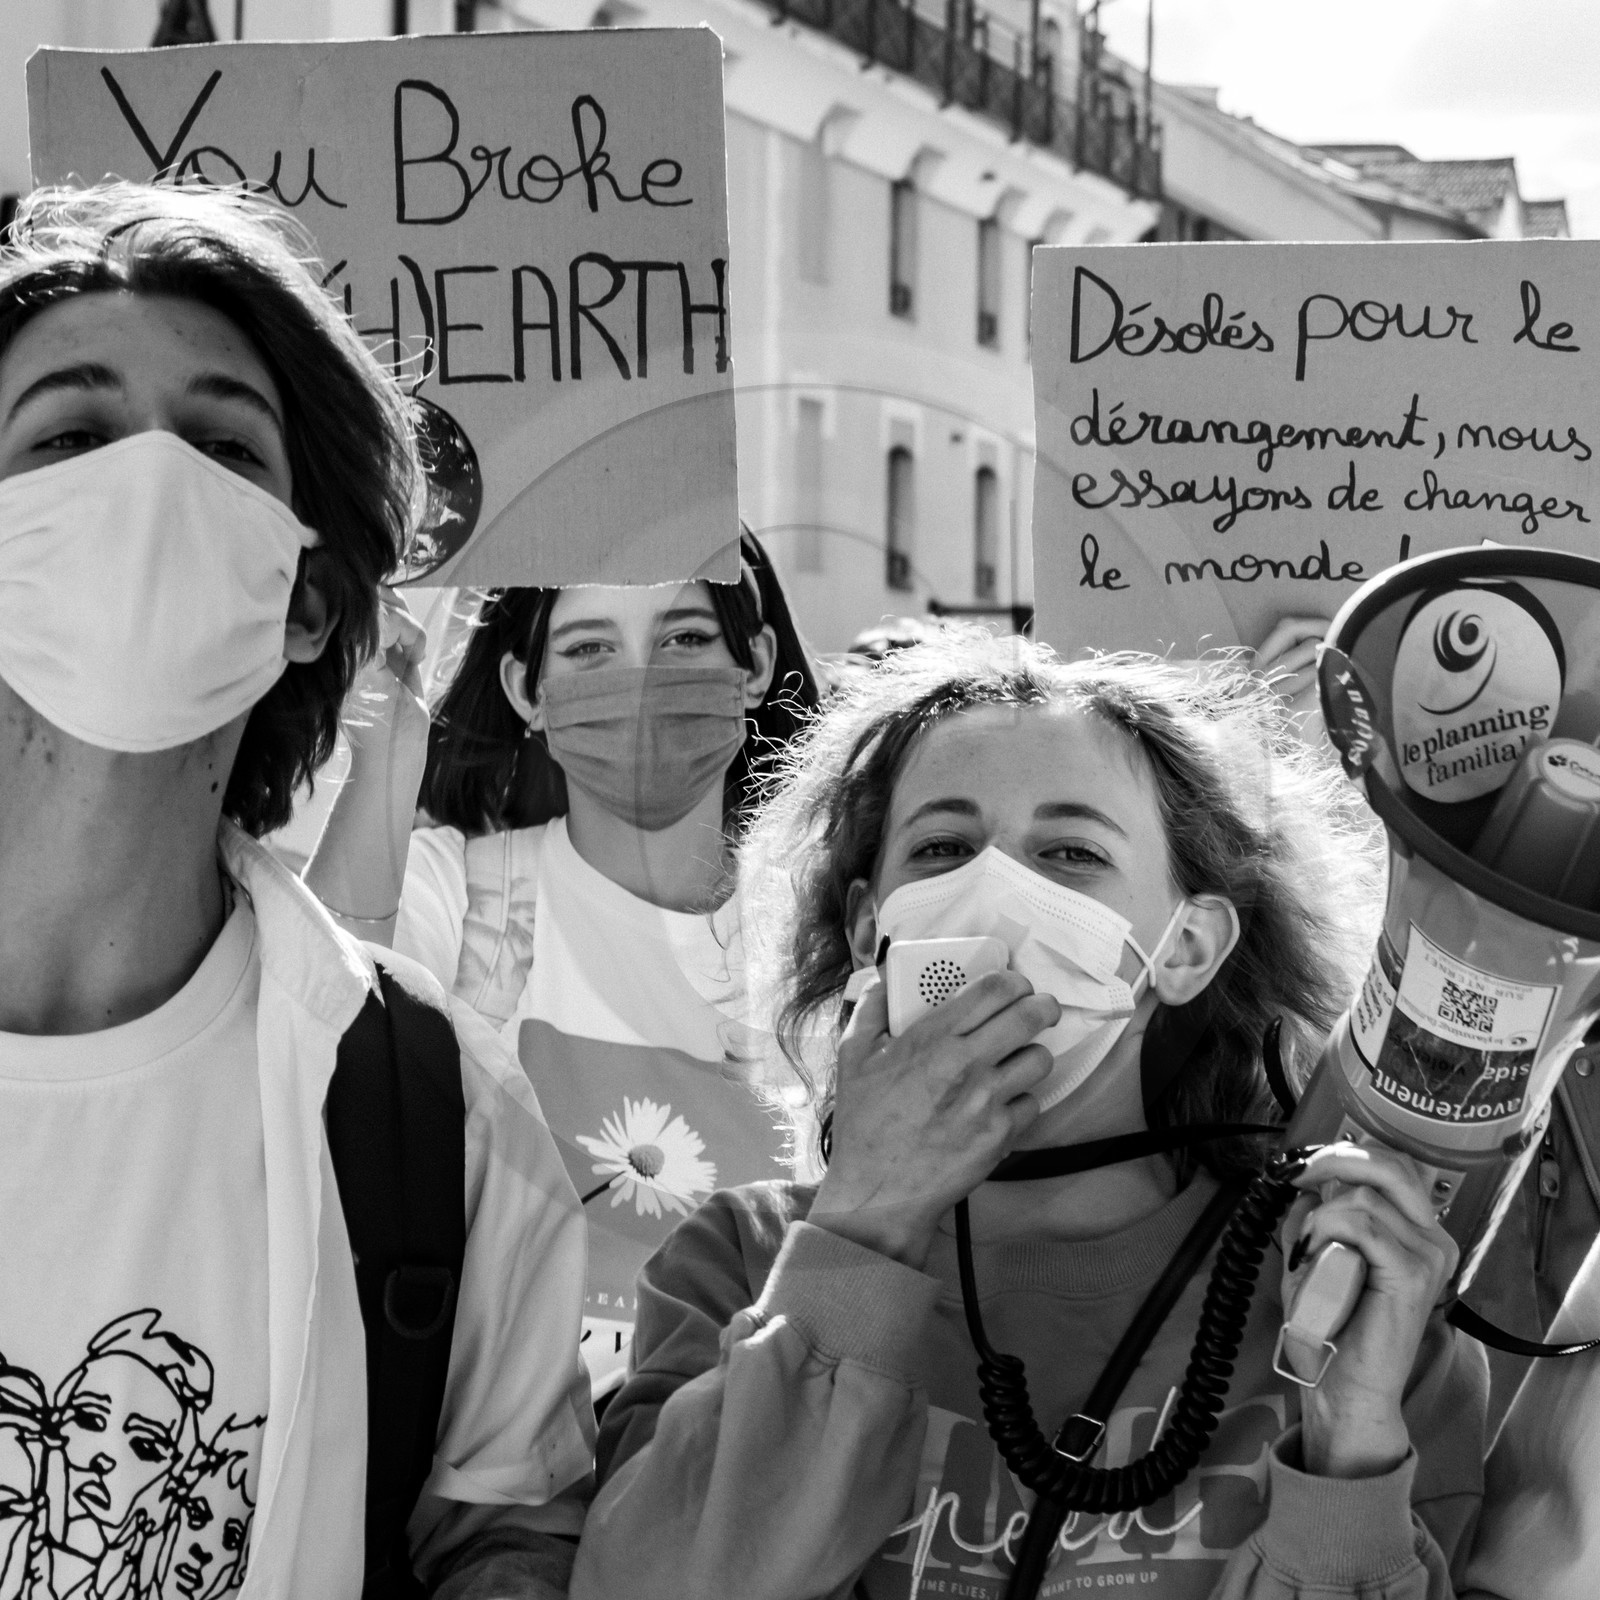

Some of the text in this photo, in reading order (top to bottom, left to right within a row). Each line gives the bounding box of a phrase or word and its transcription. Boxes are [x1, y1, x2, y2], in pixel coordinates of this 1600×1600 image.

[101, 66, 694, 225] You Broke
[323, 252, 729, 394] H)EARTH
[1070, 266, 1580, 381] Désolés pour le
[1070, 388, 1592, 471] dérangement, nous
[1072, 460, 1591, 534] essayons de changer
[1080, 533, 1131, 590] le
[1164, 540, 1369, 584] monde
[1402, 704, 1550, 767] le planning
[1376, 1068, 1521, 1121] avortement
[1482, 1062, 1530, 1082] sida
[921, 1579, 946, 1593] IME
[1041, 1579, 1072, 1597] WANT
[1075, 1576, 1092, 1588] TO
[1097, 1573, 1135, 1587] GROW
[1140, 1571, 1158, 1583] UP
